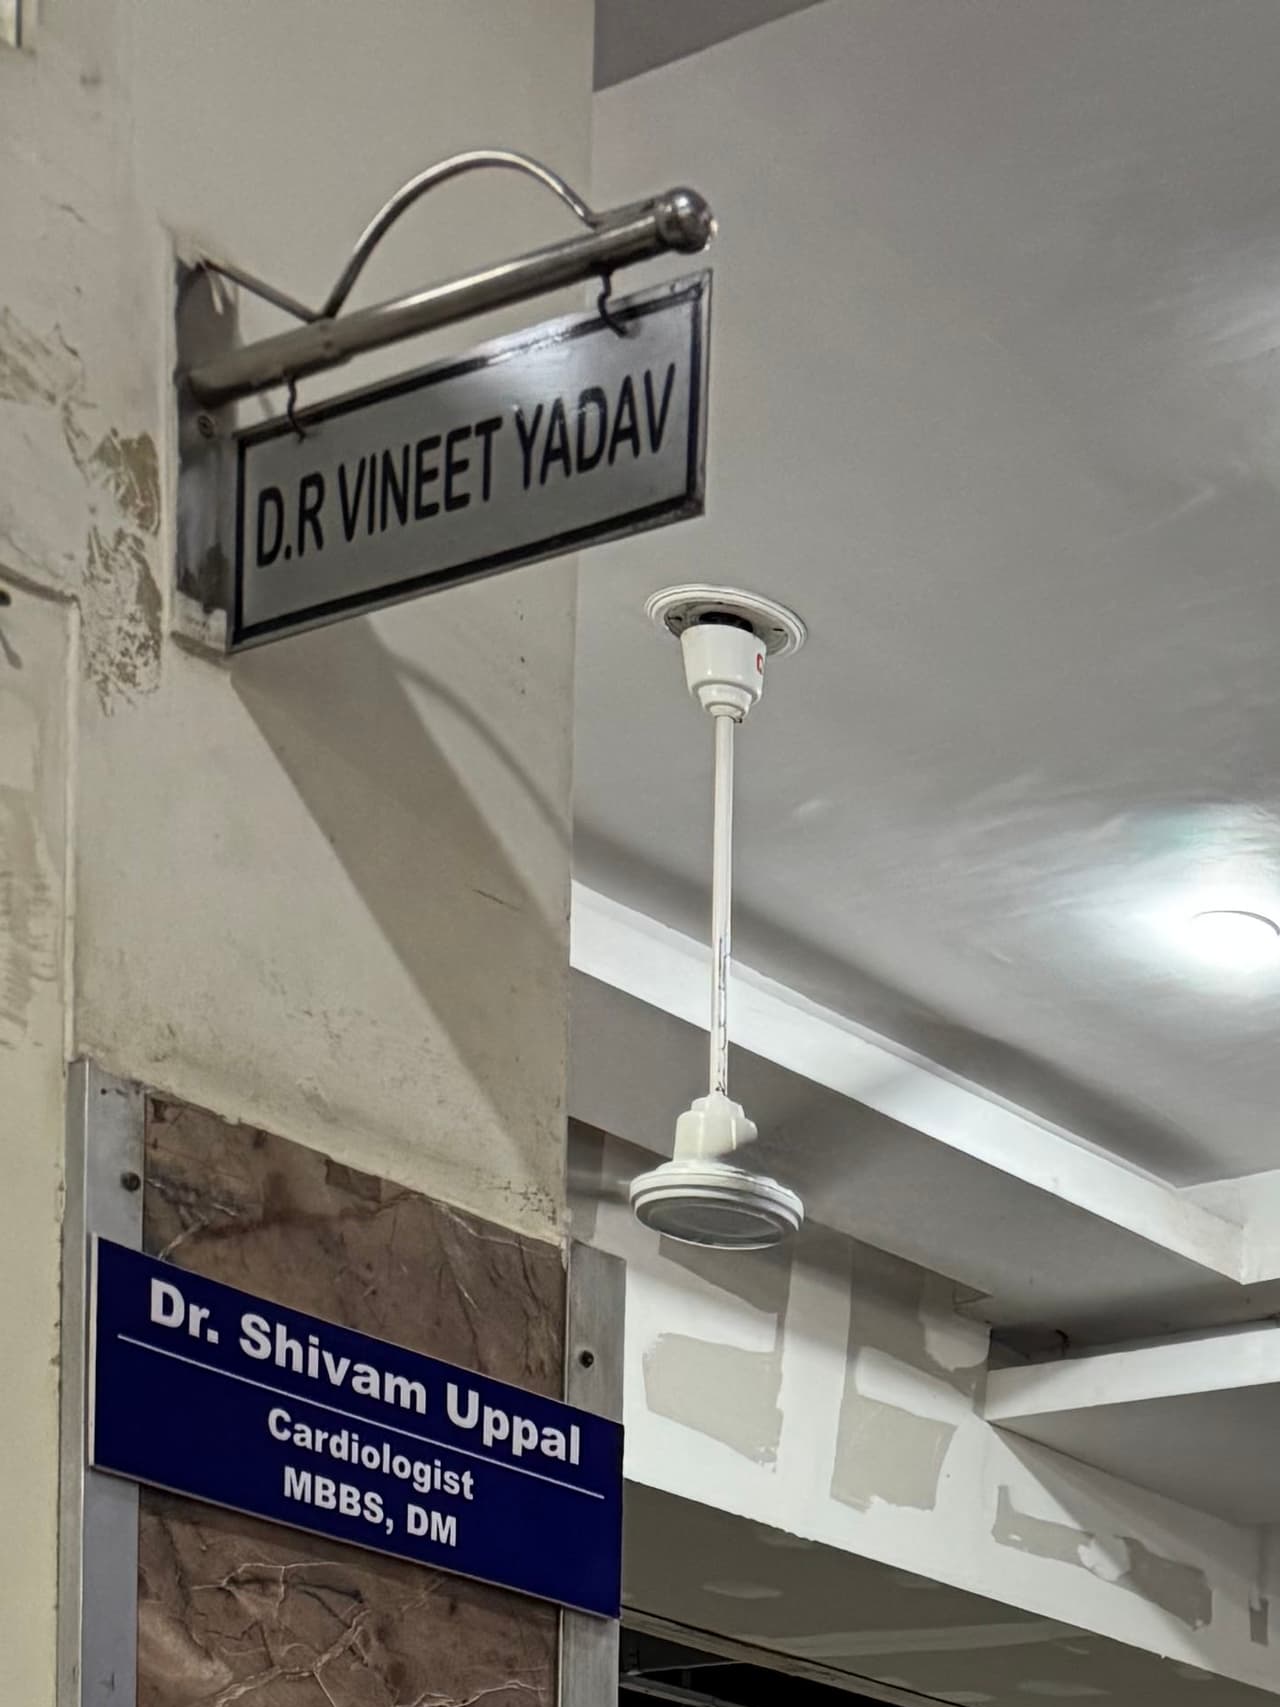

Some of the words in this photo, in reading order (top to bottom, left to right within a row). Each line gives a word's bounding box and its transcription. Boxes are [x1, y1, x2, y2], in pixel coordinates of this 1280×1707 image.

[257, 471, 326, 568] D.R
[338, 415, 504, 543] VINEET
[513, 362, 677, 491] YADAV
[149, 1277, 220, 1344] Dr.
[239, 1312, 427, 1414] Shivam
[445, 1382, 582, 1466] Uppal
[267, 1407, 474, 1500] Cardiologist
[283, 1465, 395, 1535] MBBS,
[407, 1504, 458, 1548] DM
